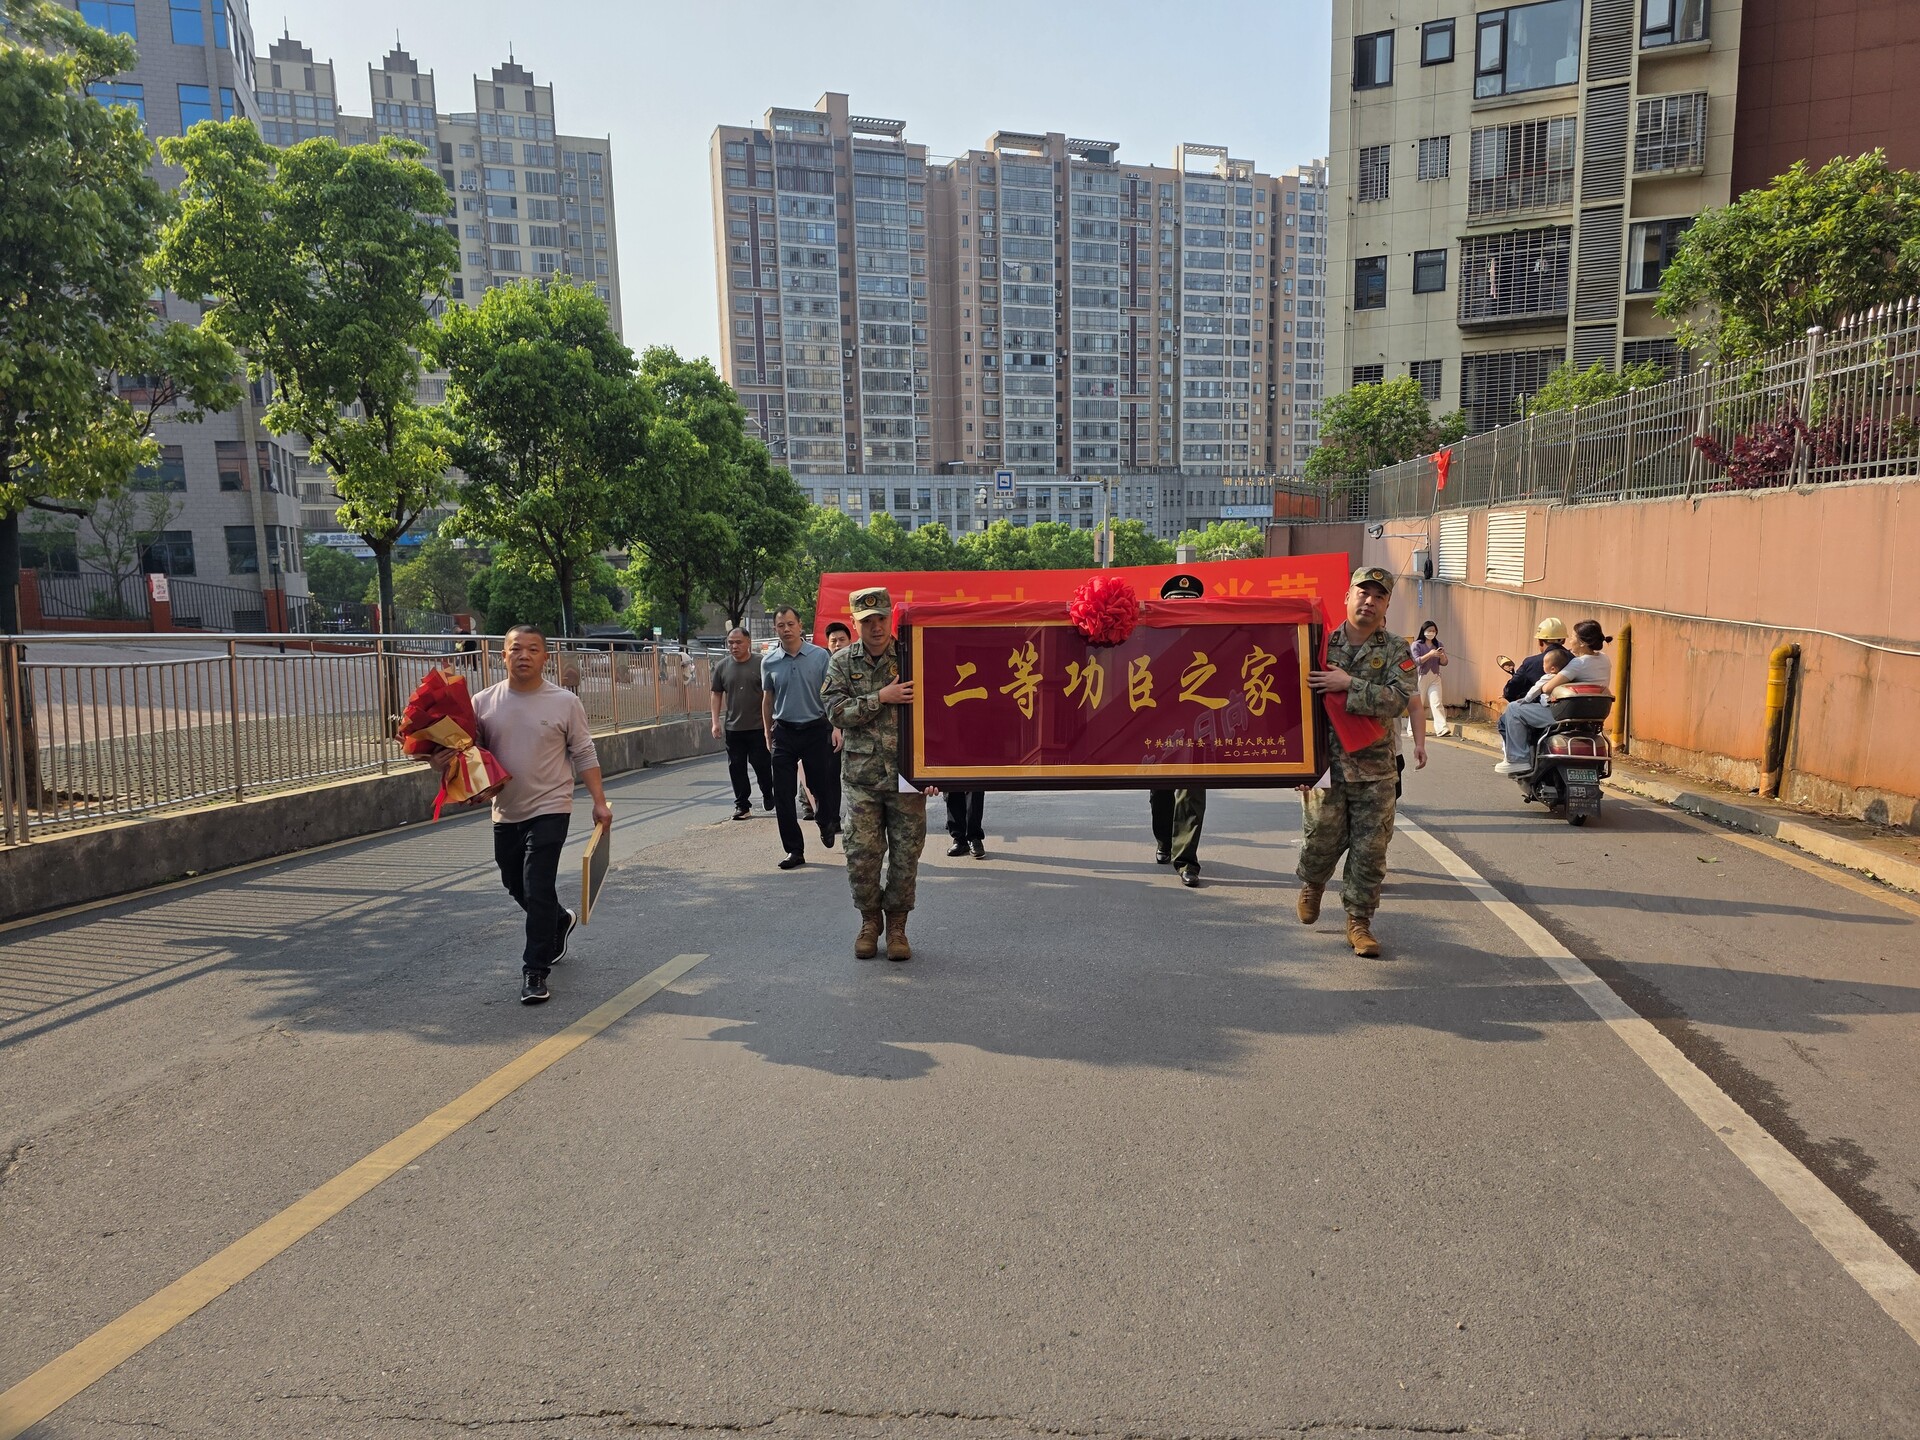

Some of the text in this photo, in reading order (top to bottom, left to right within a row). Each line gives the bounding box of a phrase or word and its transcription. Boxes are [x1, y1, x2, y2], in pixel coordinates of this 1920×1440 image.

[943, 641, 1282, 719] 二等功臣之家
[1144, 735, 1286, 749] 中共桂阳县委 桂阳县人民政府
